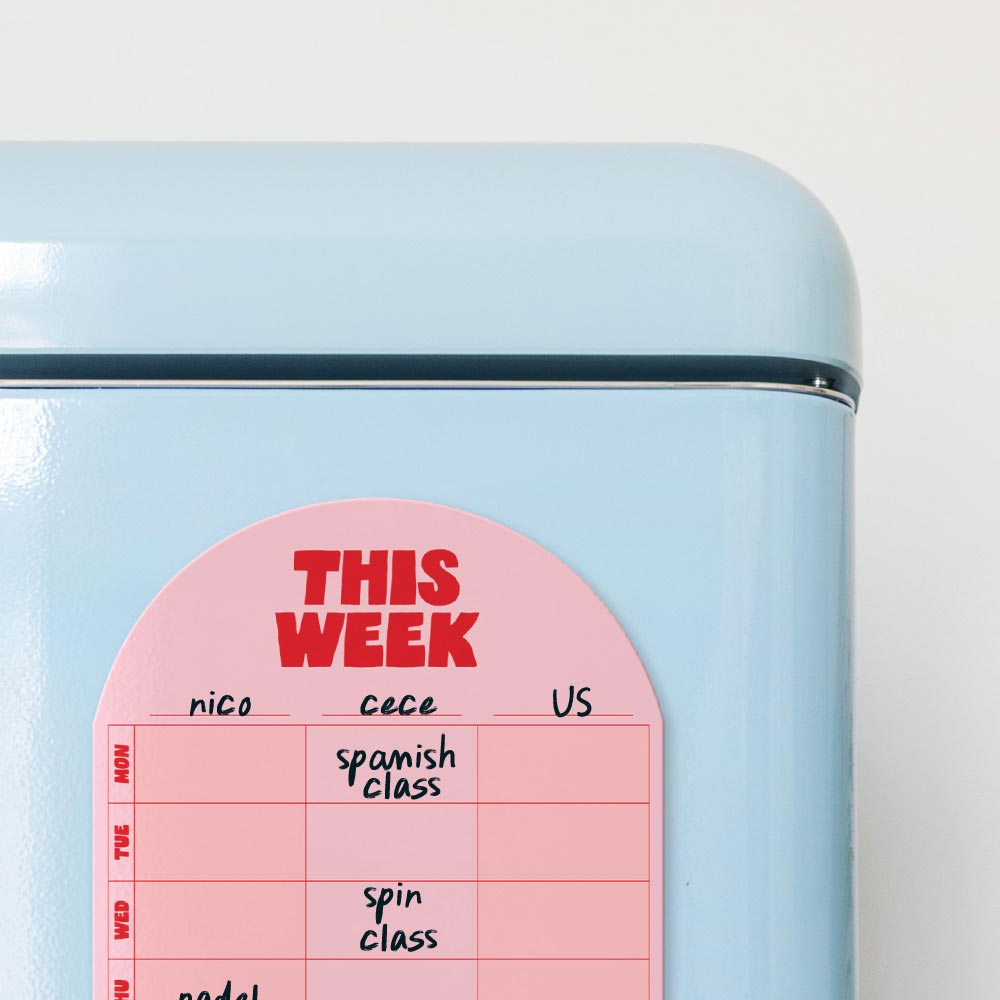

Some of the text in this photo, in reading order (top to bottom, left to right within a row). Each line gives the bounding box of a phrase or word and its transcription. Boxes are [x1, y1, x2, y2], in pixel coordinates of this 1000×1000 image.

[293, 549, 460, 606] THIS
[275, 612, 479, 668] WEEK
[189, 690, 252, 717] nico
[359, 694, 438, 716] cece
[552, 686, 592, 718] US
[113, 744, 130, 784] MON
[336, 733, 456, 787] spanish
[363, 771, 441, 800] class
[114, 824, 130, 861] TUE
[114, 900, 130, 940] WED
[363, 882, 422, 925] spin
[359, 923, 438, 952] class
